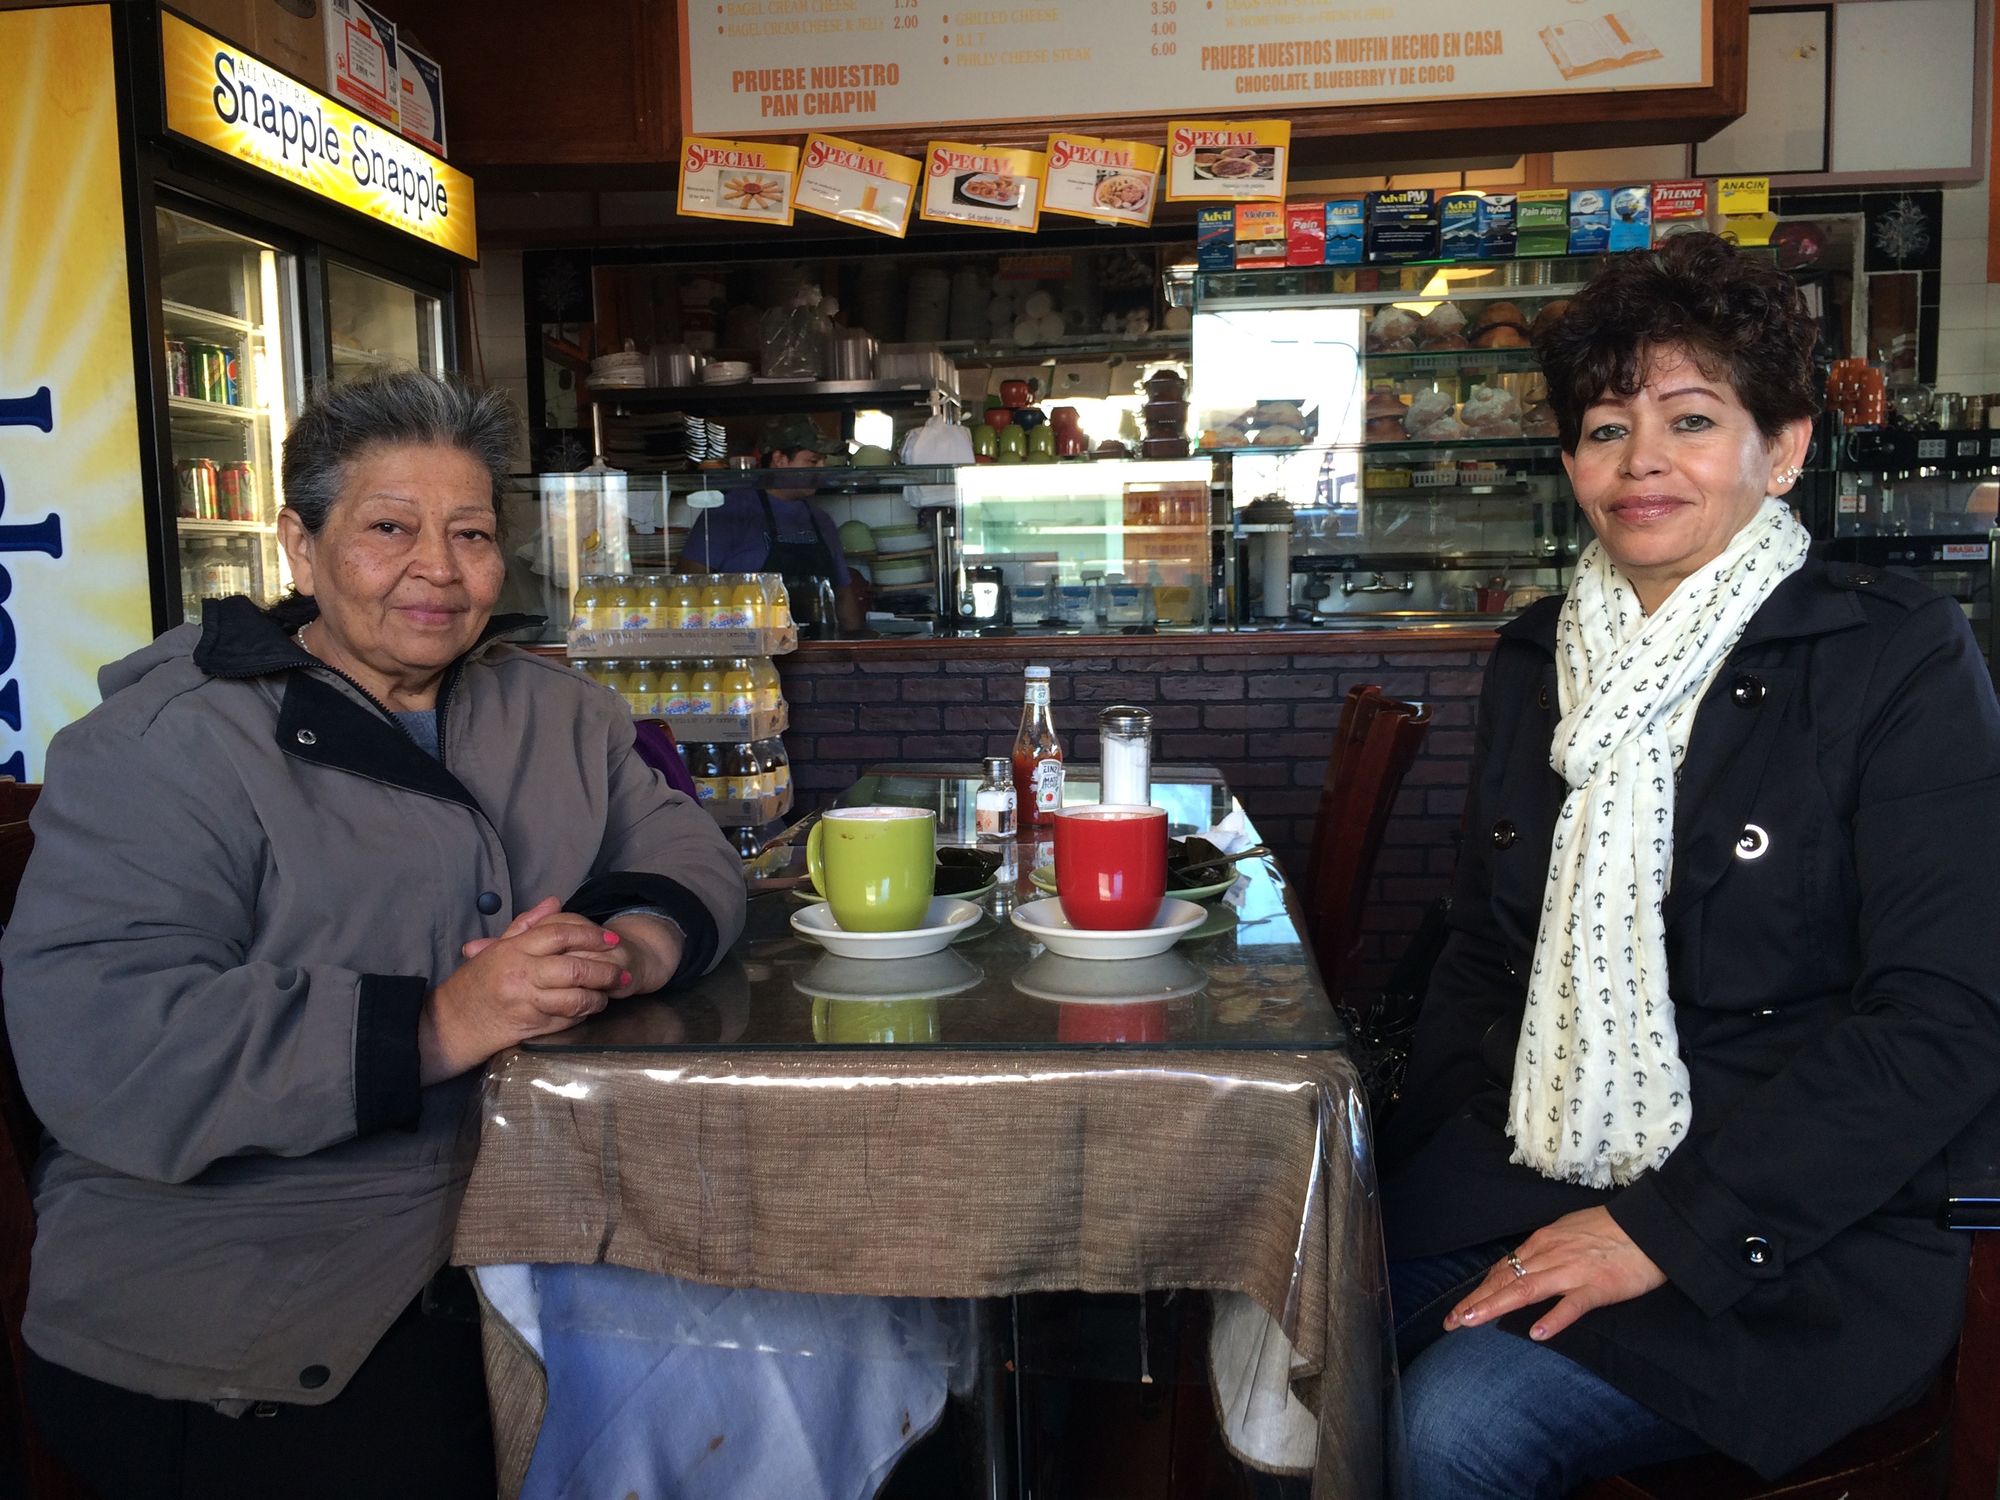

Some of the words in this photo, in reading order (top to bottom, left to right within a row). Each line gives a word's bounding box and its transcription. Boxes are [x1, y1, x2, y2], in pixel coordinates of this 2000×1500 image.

[1012, 8, 1058, 23] CHEESE
[1151, 1, 1177, 15] 3.50
[893, 16, 919, 29] 2.00
[1151, 21, 1177, 36] 4.00
[1151, 42, 1177, 56] 6.00
[1201, 44, 1255, 71] PRUEBE
[1258, 39, 1332, 68] NUESTROS
[1335, 36, 1388, 64] MUFFIN
[1391, 33, 1440, 60] HECHO
[1443, 31, 1461, 58] EN
[1464, 30, 1504, 57] CASA
[732, 68, 806, 93] PRUEBE
[811, 63, 900, 89] NUESTRO
[1313, 68, 1386, 90] BLUEBERRY
[1388, 67, 1397, 86] Y
[1399, 66, 1416, 86] DE
[1418, 64, 1455, 84] COCO
[213, 51, 340, 168] Snapple
[761, 94, 798, 117] PAN
[803, 90, 877, 116] CHAPIN
[352, 125, 449, 221] Snapple
[1722, 181, 1766, 190] ANACIN
[1379, 194, 1407, 204] Advil
[1407, 191, 1427, 203] PM
[1655, 189, 1703, 199] TYLENOL
[1201, 210, 1232, 222] Advil
[1520, 207, 1539, 217] Pain
[1540, 207, 1563, 217] Away
[1292, 219, 1319, 231] Pain
